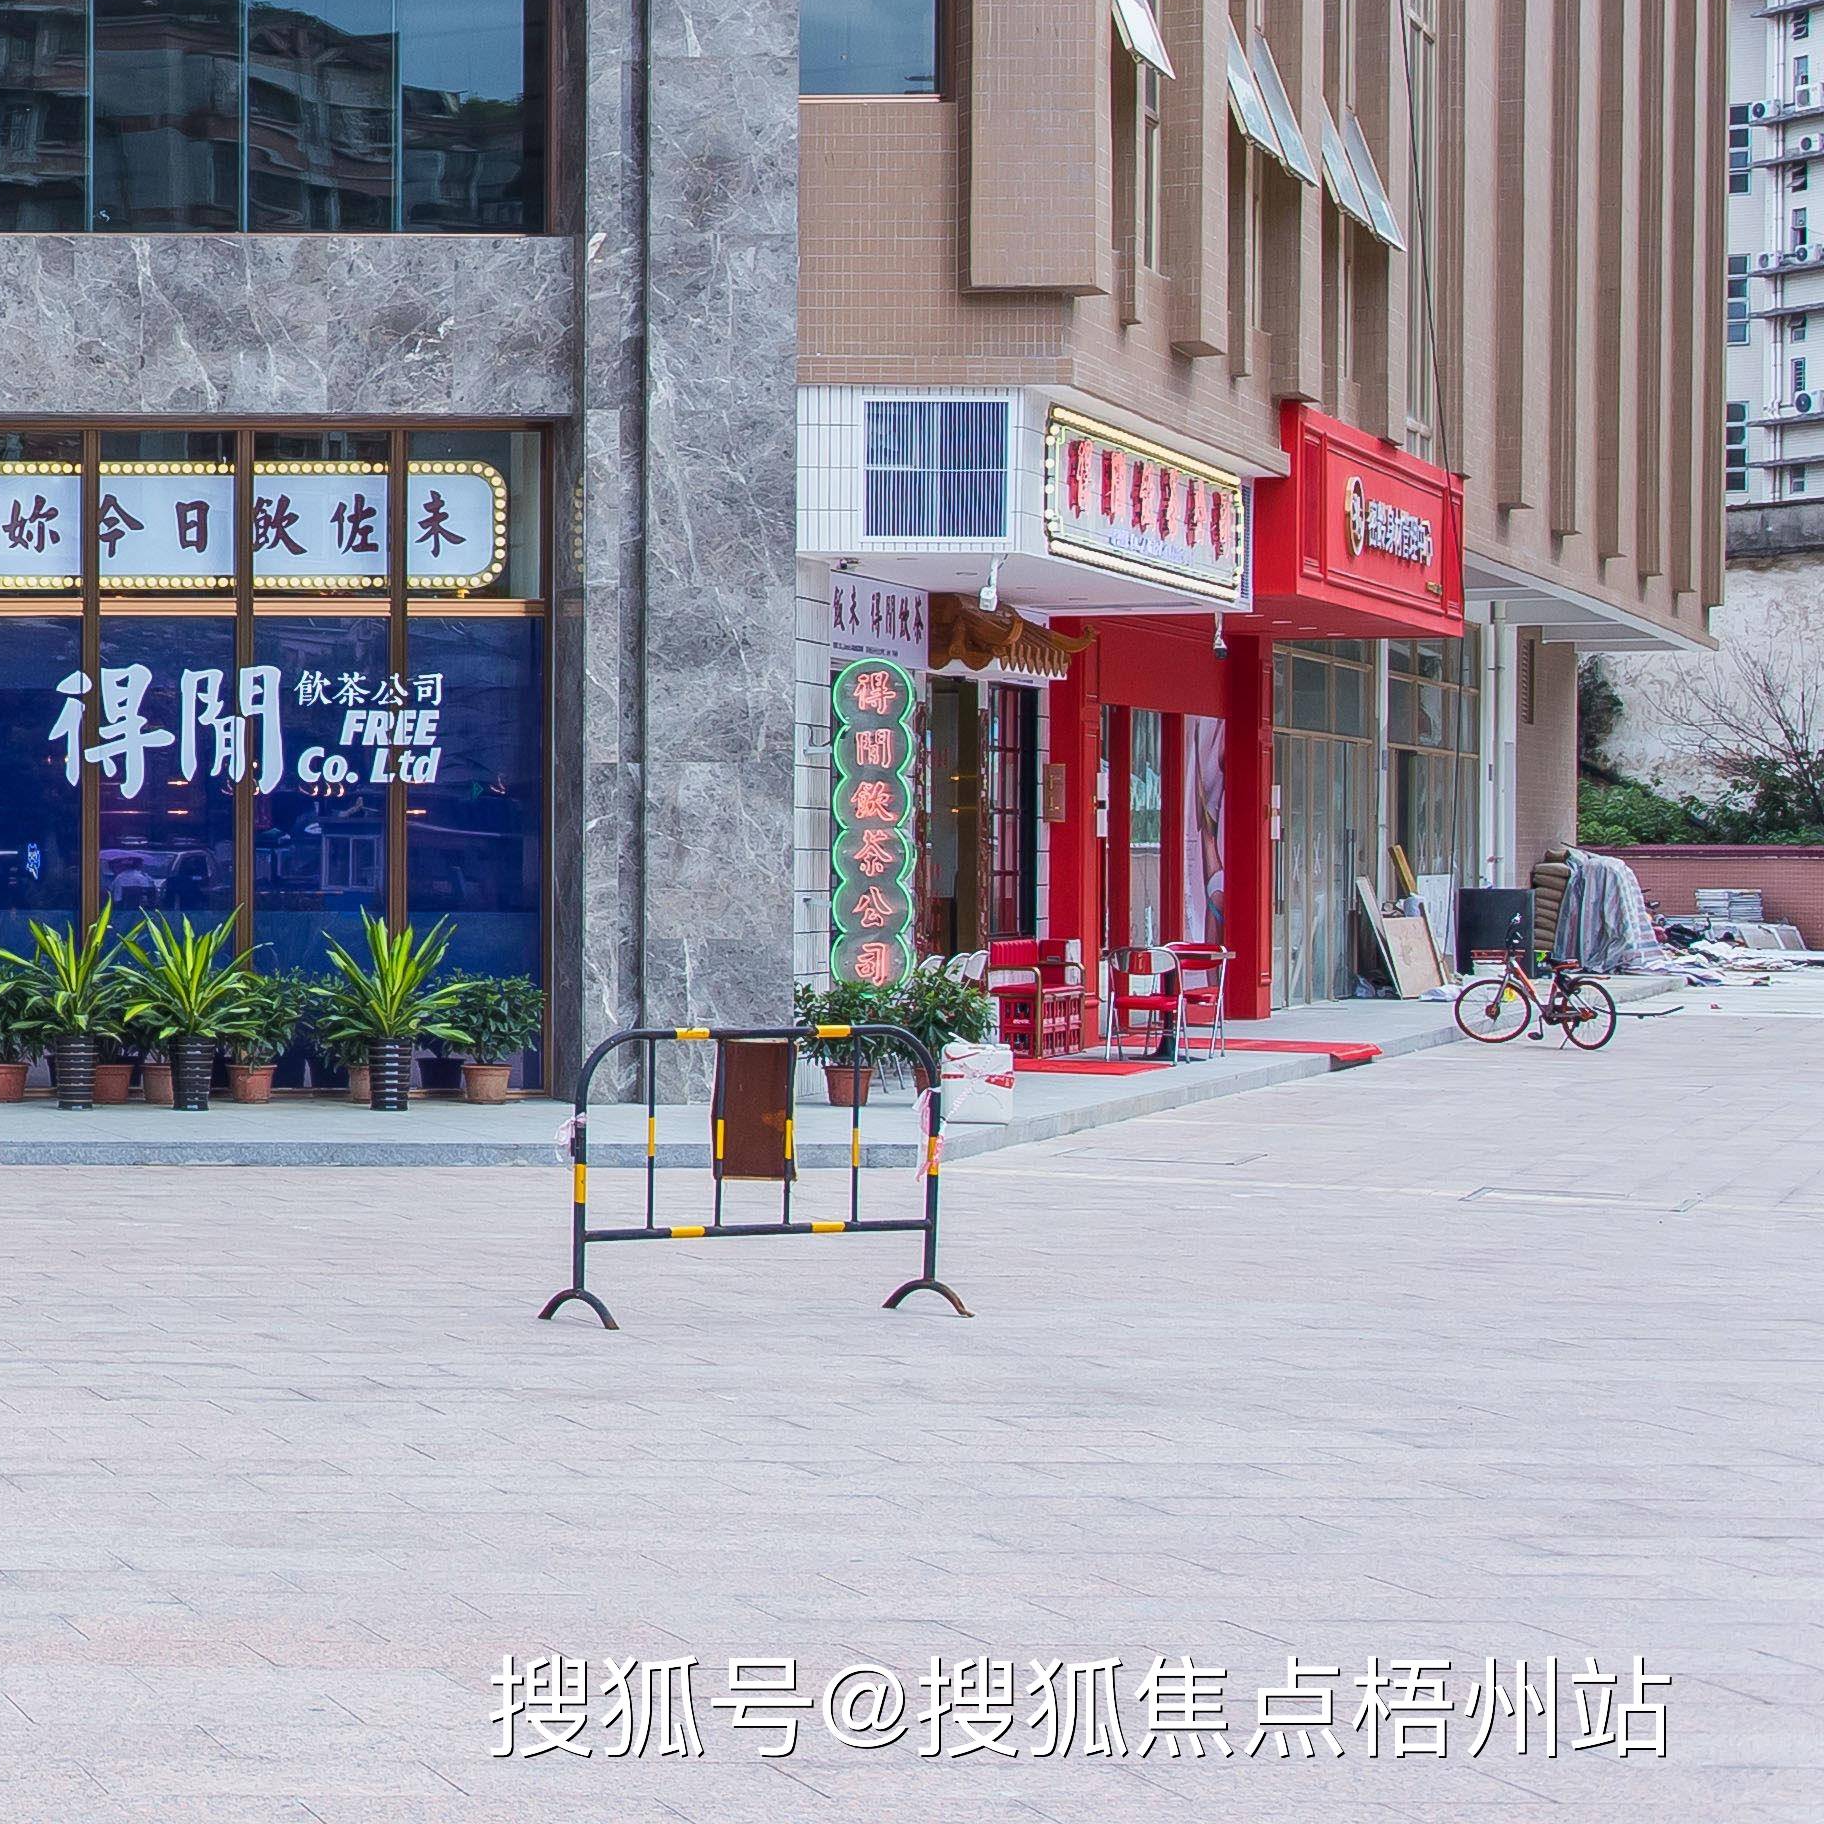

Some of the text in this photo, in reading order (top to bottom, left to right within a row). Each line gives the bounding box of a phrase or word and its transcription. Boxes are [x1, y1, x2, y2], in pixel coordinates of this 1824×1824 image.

[293, 669, 444, 707] 飲茶公司
[339, 710, 441, 746] FREE
[297, 747, 442, 784] Co. Ltd
